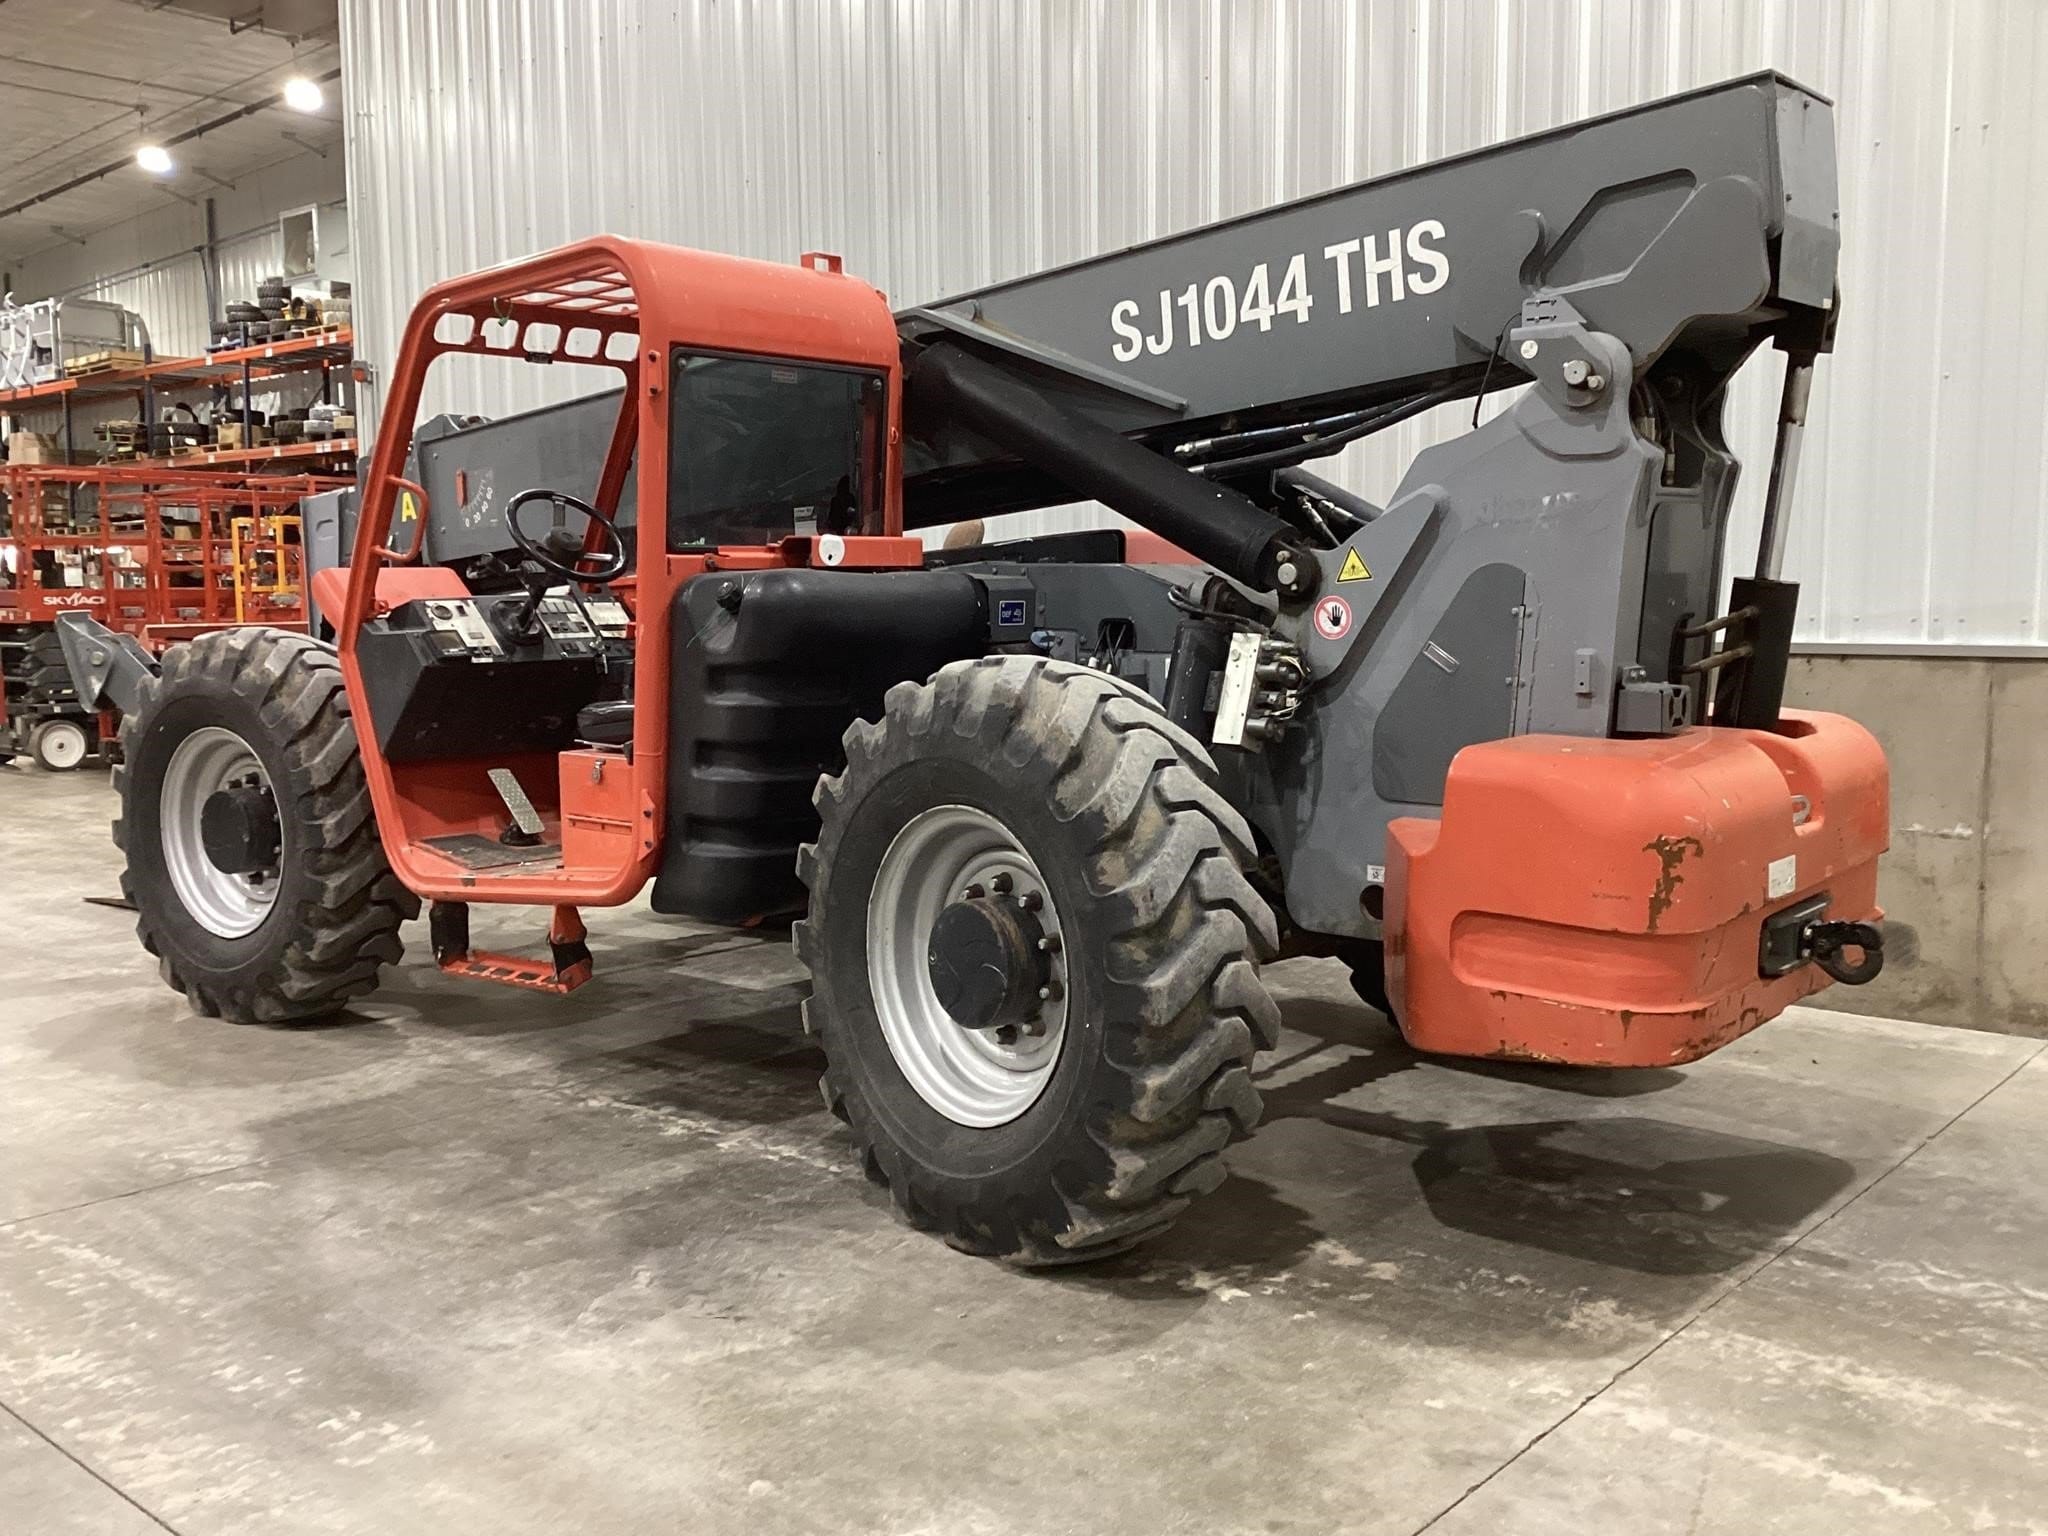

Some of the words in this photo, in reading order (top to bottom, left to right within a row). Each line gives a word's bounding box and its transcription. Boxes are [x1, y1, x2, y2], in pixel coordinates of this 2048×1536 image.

[1111, 253, 1313, 362] SJ1044
[1324, 219, 1450, 314] THS
[401, 491, 417, 522] A
